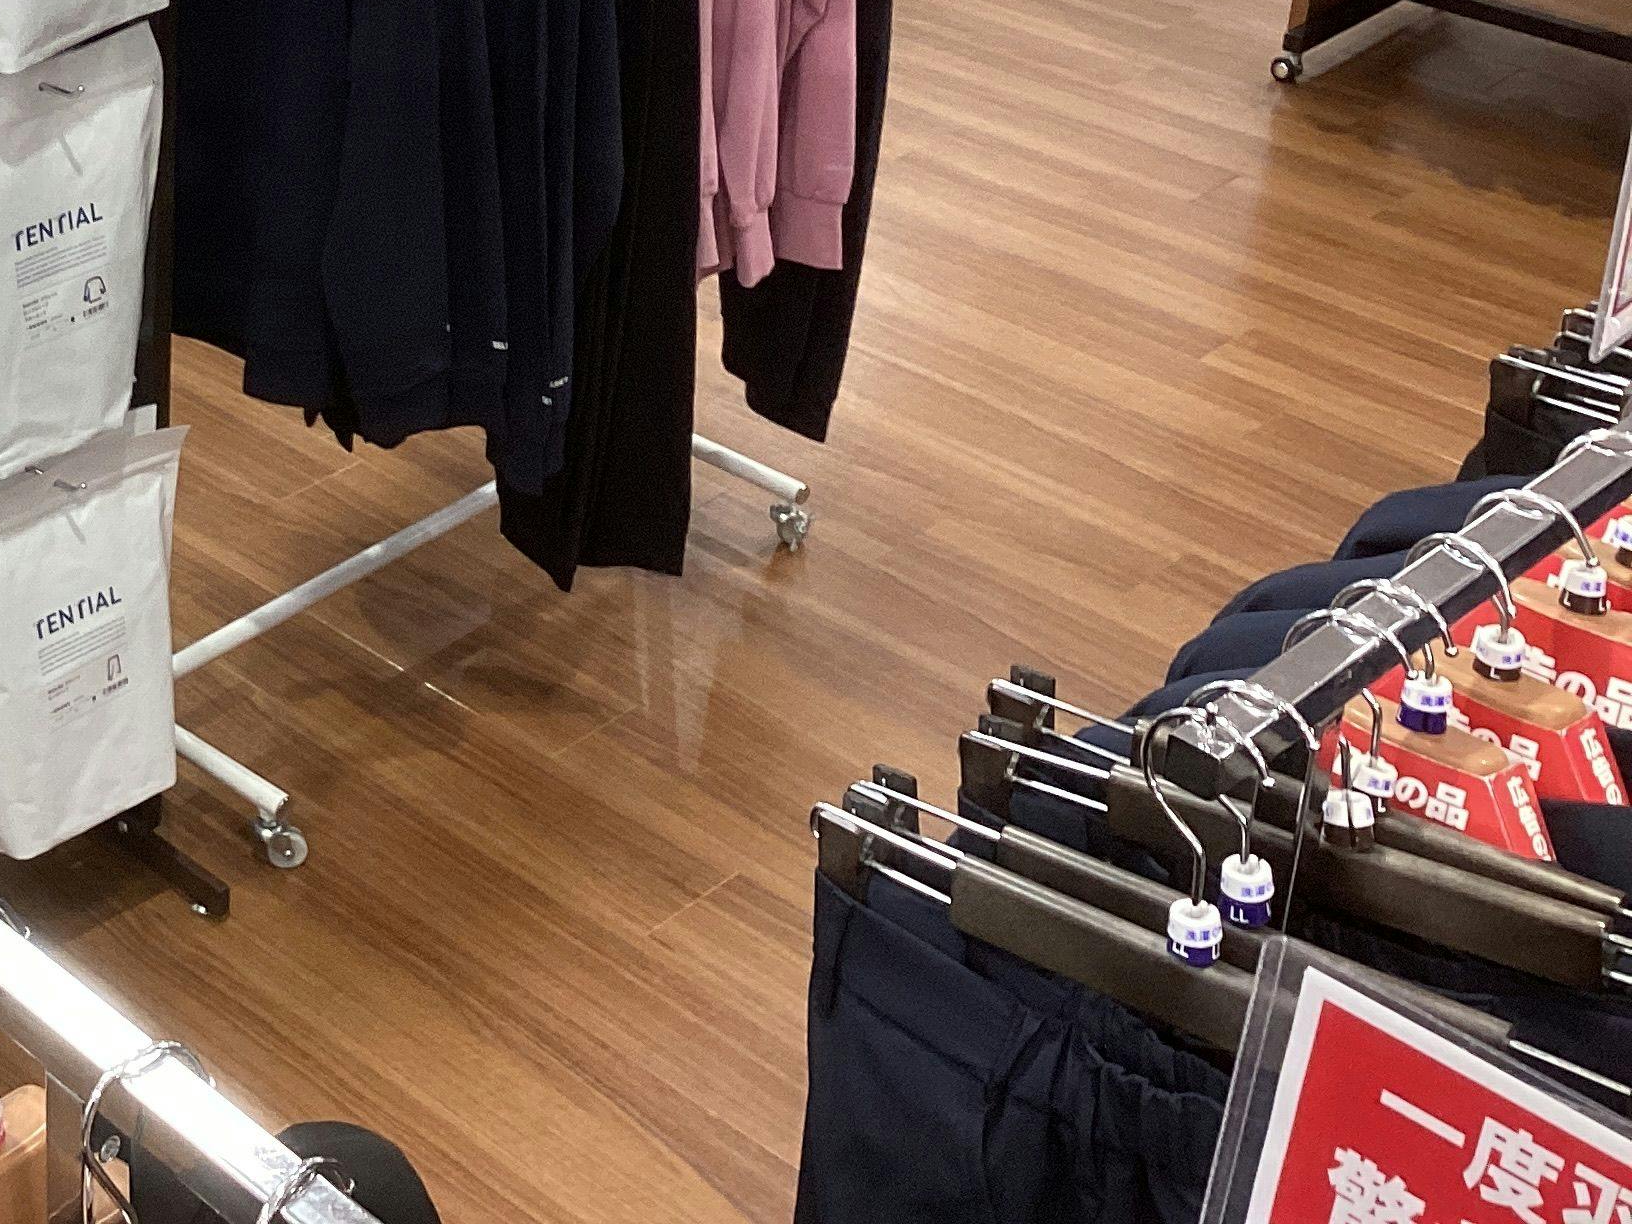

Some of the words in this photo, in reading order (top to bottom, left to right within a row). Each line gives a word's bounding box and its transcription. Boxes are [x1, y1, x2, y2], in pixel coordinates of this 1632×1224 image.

[10, 201, 104, 252] TENTIAL
[35, 585, 123, 641] TENTIAL
[1229, 904, 1250, 925] LL
